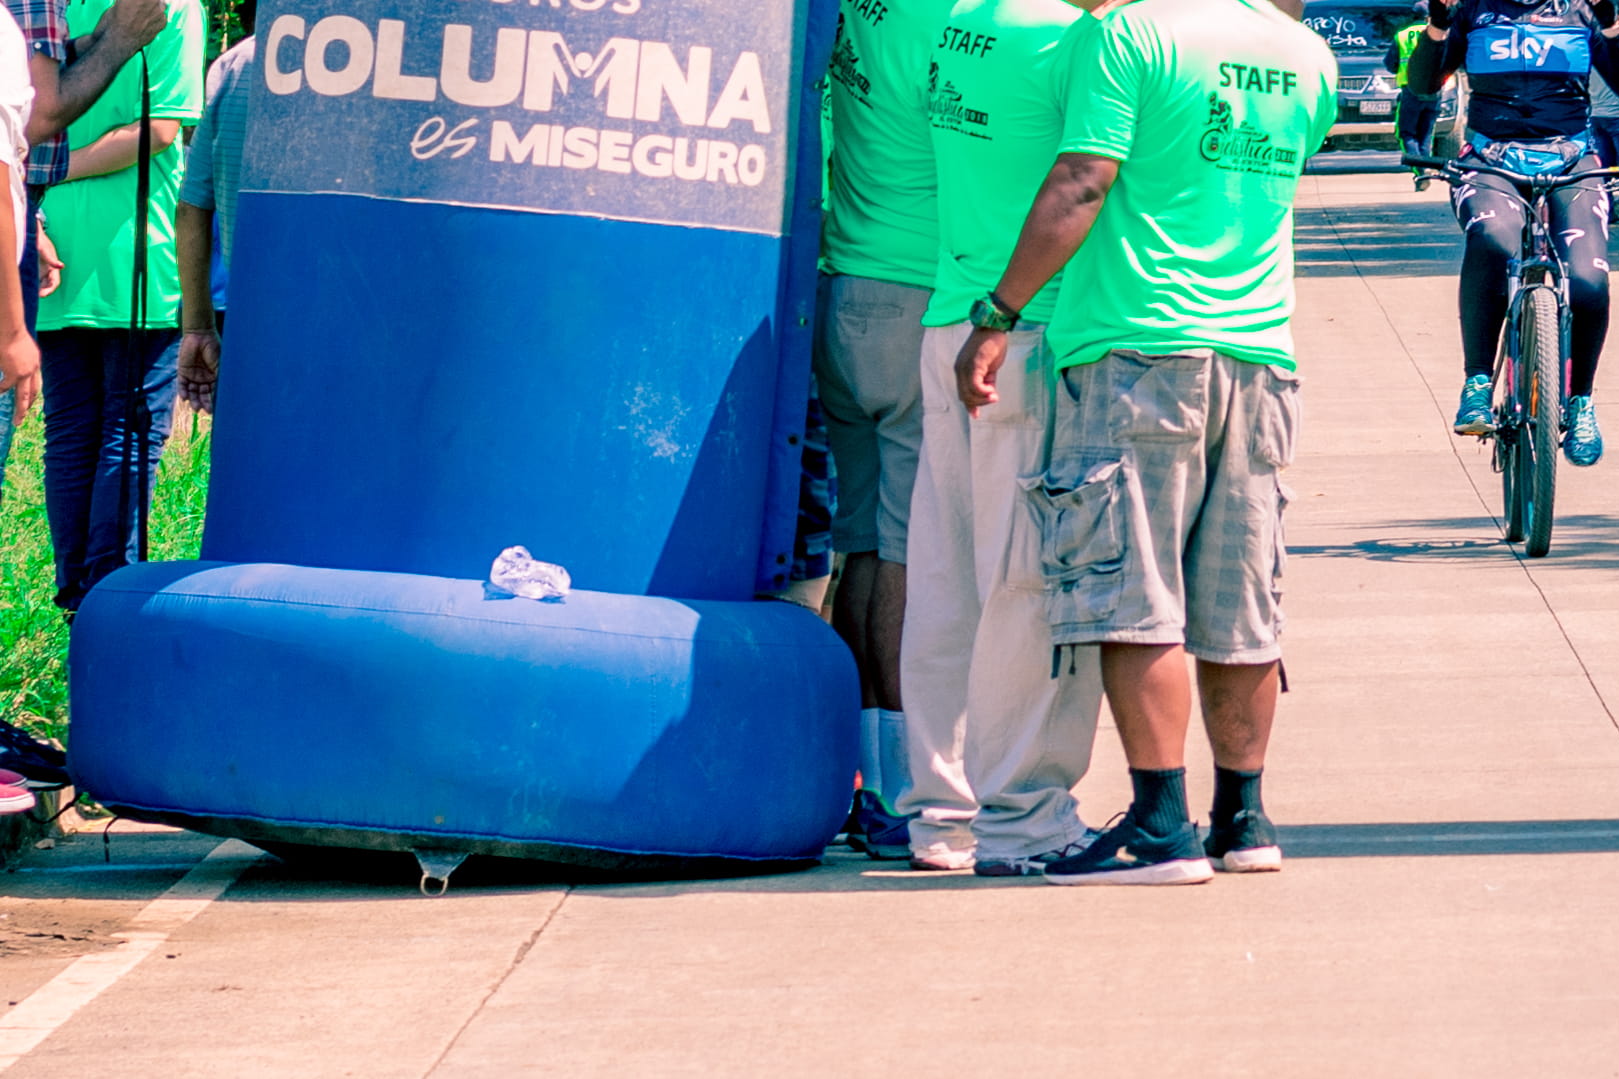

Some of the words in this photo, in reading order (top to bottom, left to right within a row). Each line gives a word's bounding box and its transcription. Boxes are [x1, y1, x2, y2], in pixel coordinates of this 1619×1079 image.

[938, 26, 998, 59] STAFF
[1489, 29, 1554, 67] sky
[264, 14, 772, 134] COLUMNA
[1219, 62, 1297, 96] STAFF
[409, 116, 479, 161] es
[488, 121, 766, 187] MISEGURO
